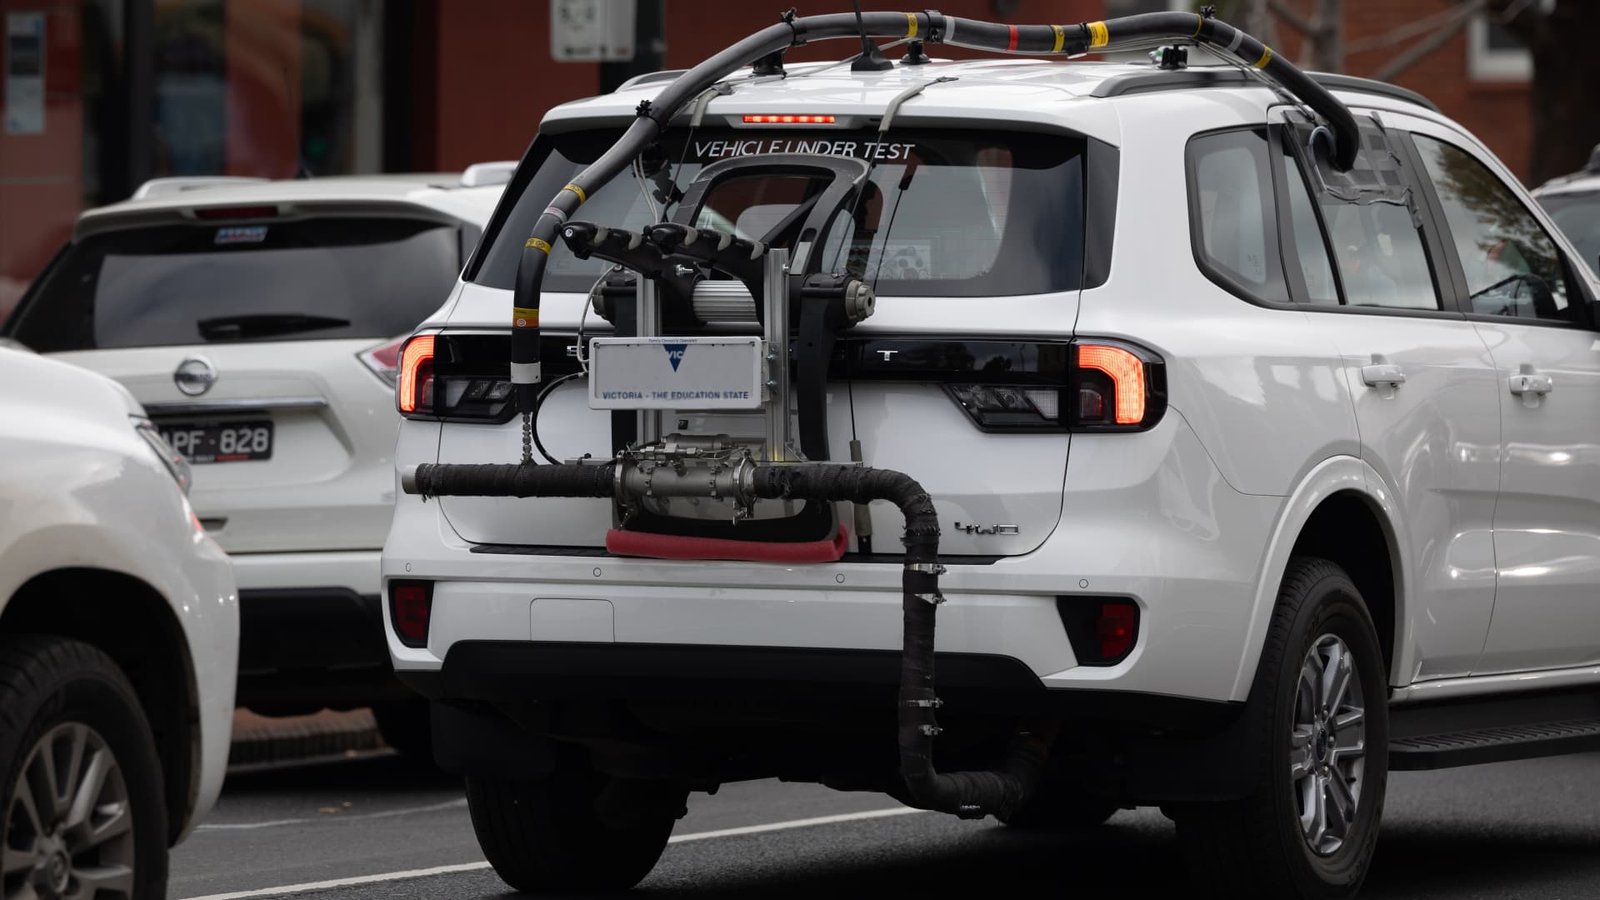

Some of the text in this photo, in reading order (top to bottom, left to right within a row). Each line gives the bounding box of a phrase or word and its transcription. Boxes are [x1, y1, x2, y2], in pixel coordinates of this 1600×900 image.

[695, 140, 916, 160] VEHICLE UNDER TEST
[667, 350, 684, 359] VIC
[602, 391, 643, 400] VICTORIA
[652, 391, 669, 400] THE
[671, 391, 720, 400] EDUCATION
[722, 391, 749, 400] STATE
[219, 427, 270, 454] 828
[954, 521, 1019, 535] 4WD
